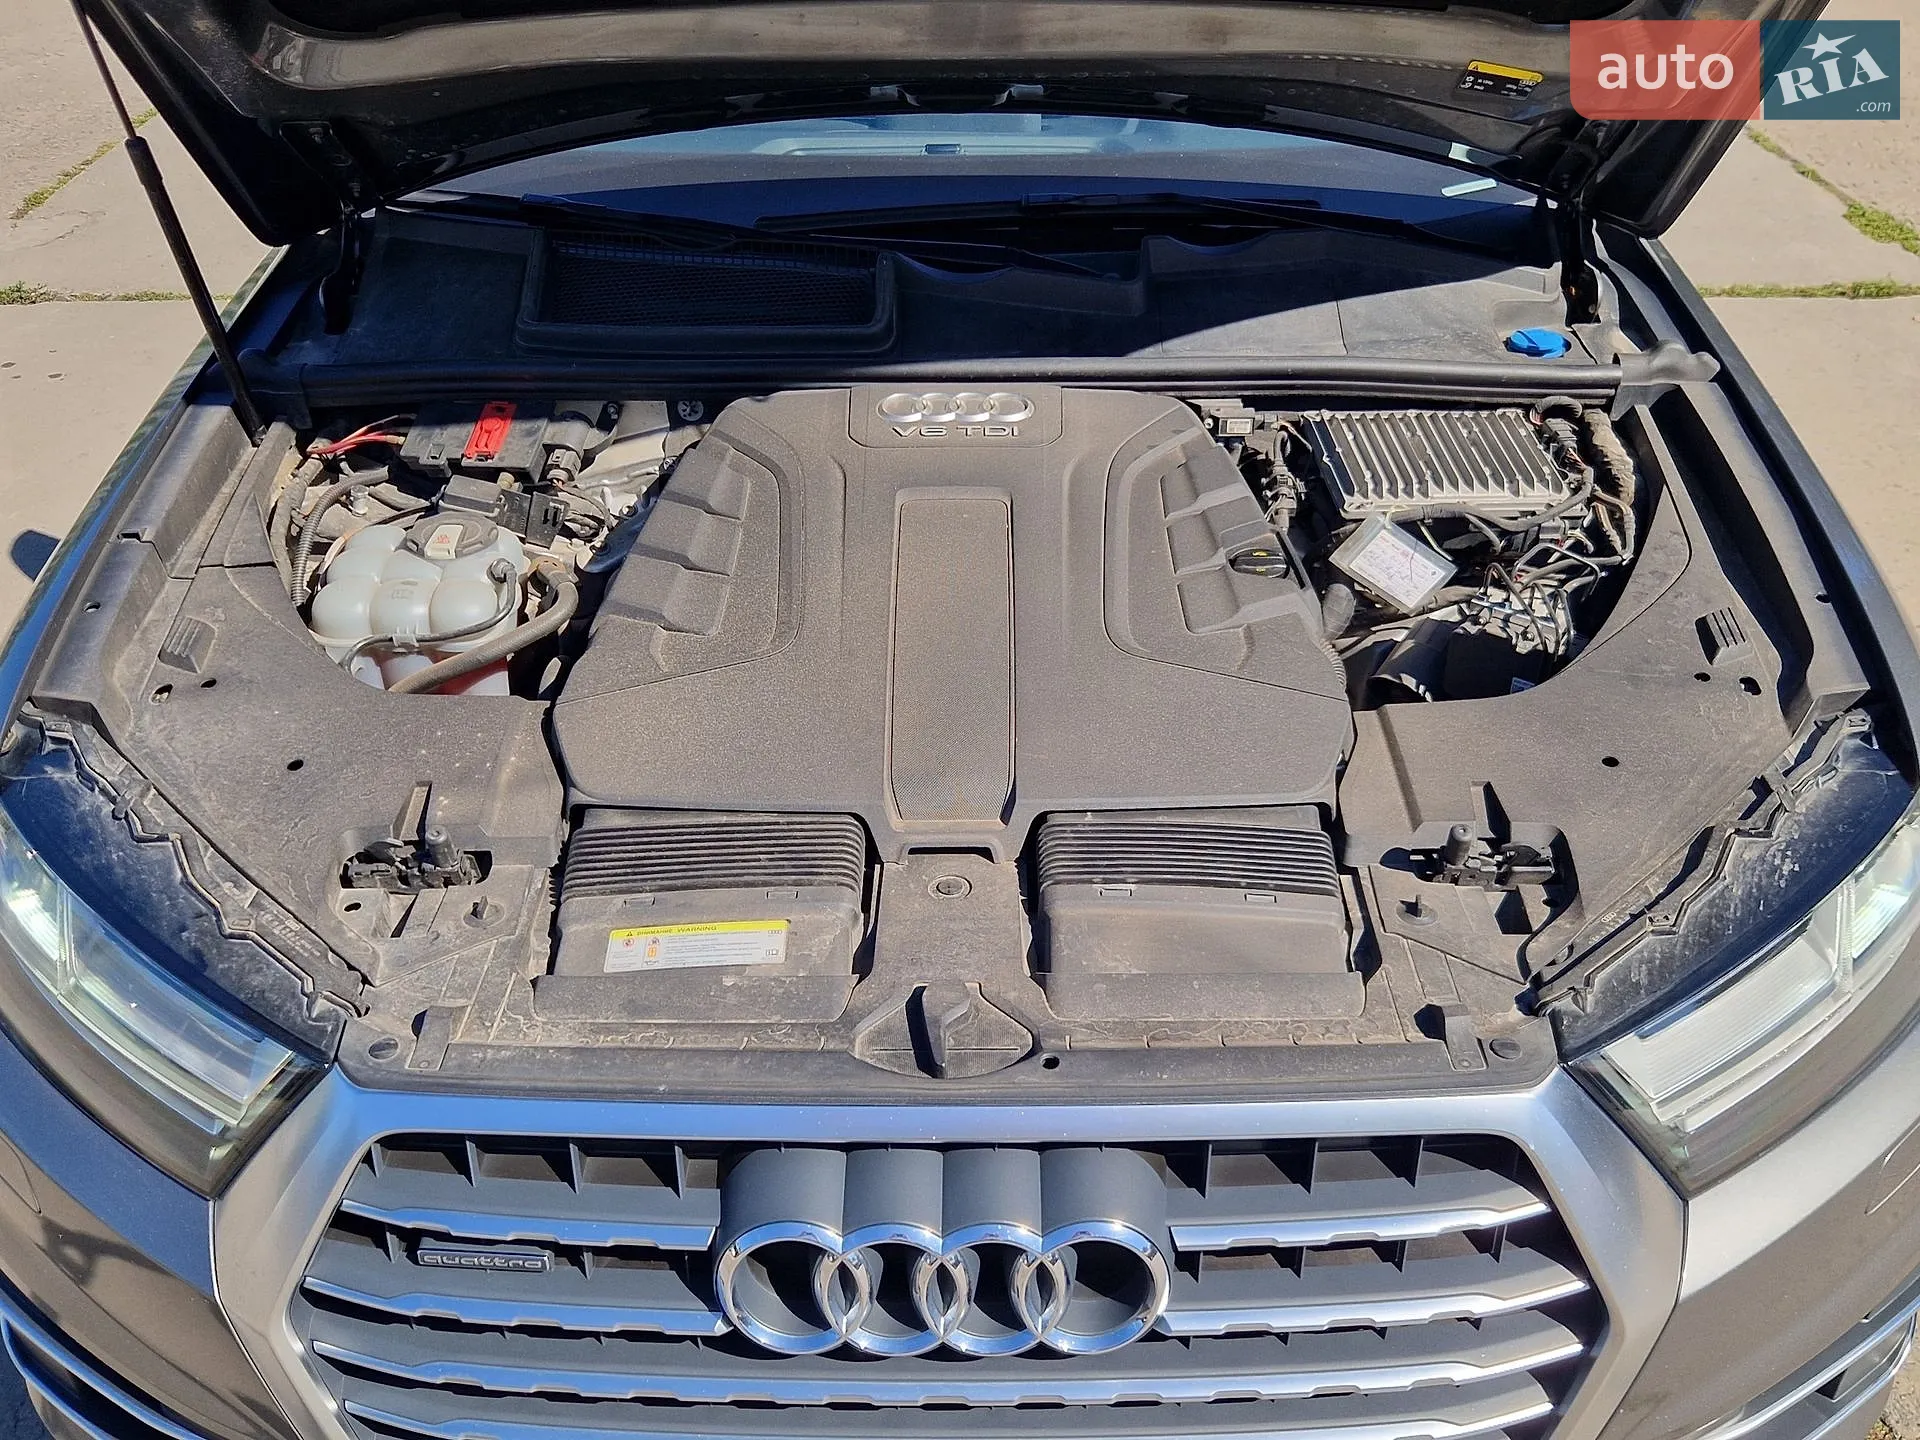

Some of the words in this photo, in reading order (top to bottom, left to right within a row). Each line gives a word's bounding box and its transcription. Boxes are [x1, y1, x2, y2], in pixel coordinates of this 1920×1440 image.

[892, 425, 948, 438] V6
[956, 425, 1019, 438] TDI
[423, 1254, 543, 1269] quattro
